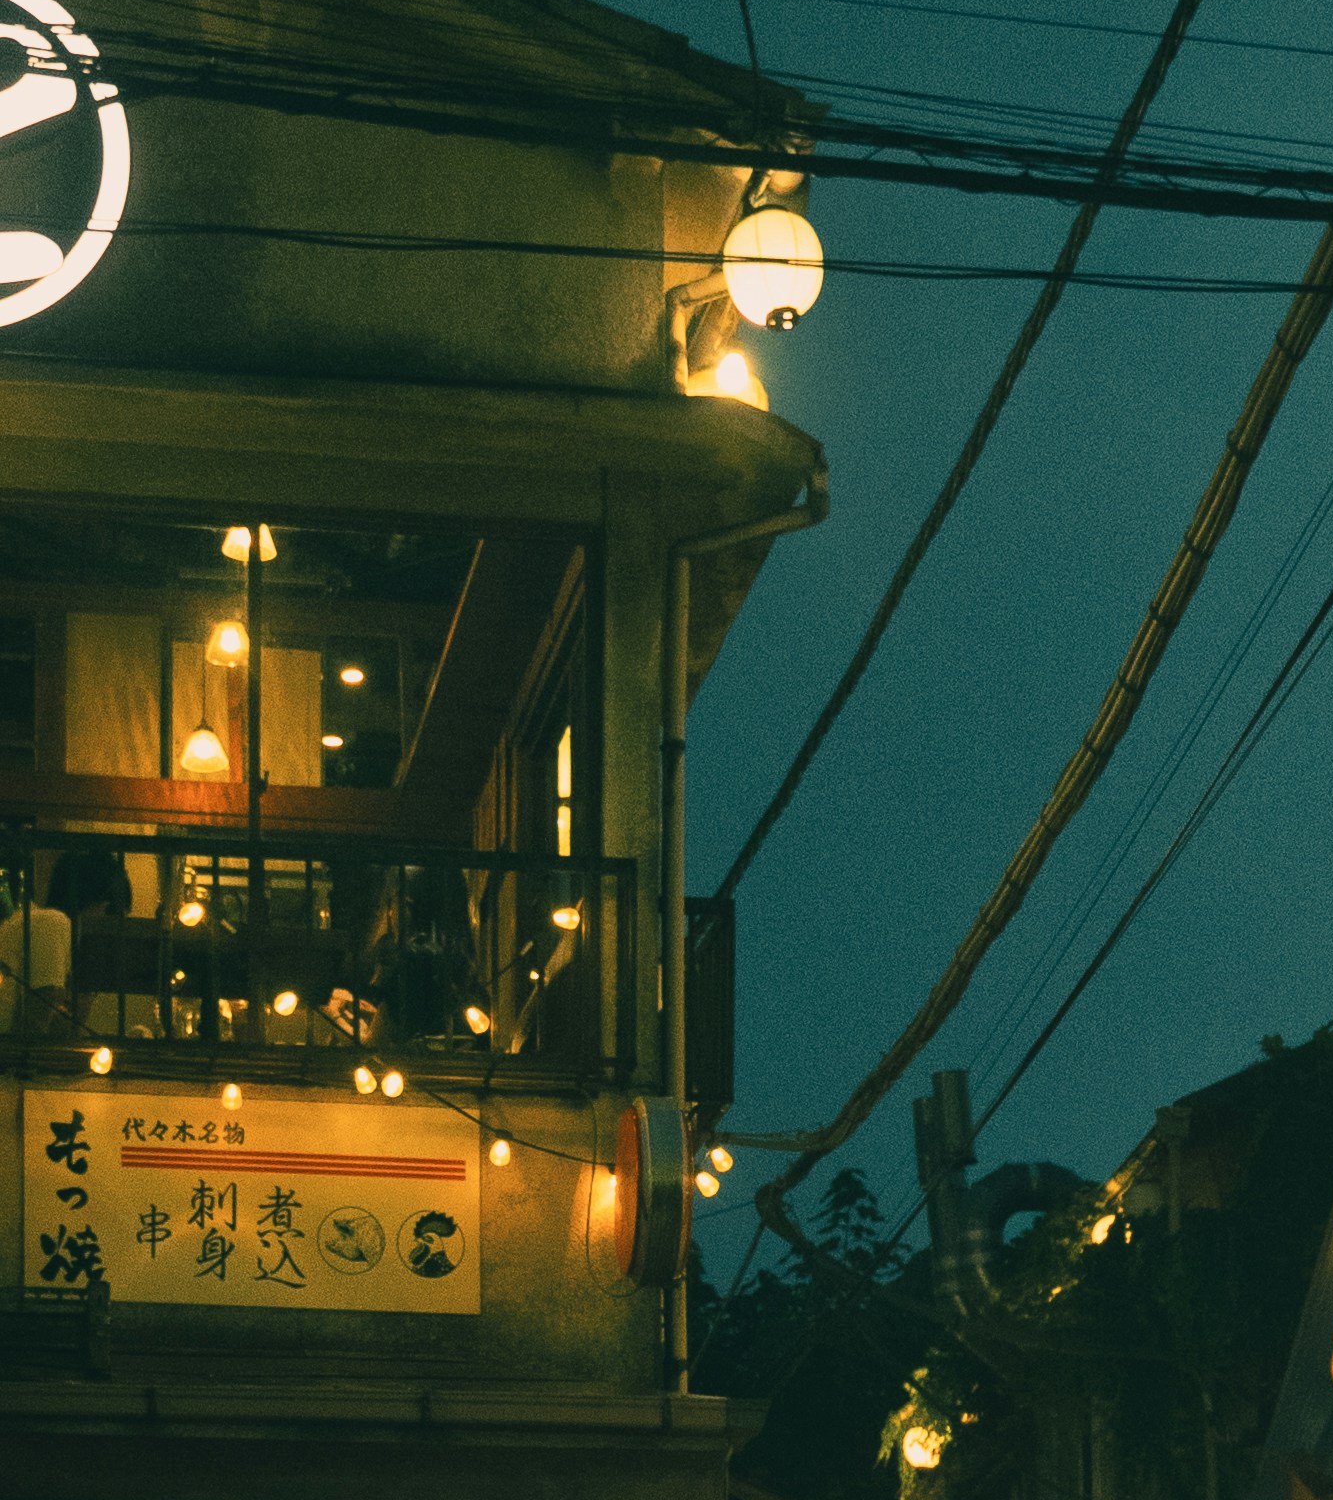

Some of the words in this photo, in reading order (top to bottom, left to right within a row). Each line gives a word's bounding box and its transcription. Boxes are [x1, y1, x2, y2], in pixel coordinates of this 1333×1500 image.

[121, 1116, 246, 1146] 代々木名物
[40, 1110, 105, 1284] もつ焼
[135, 1204, 173, 1259] 串
[187, 1178, 238, 1284] 刺身
[254, 1185, 307, 1289] 煮込
